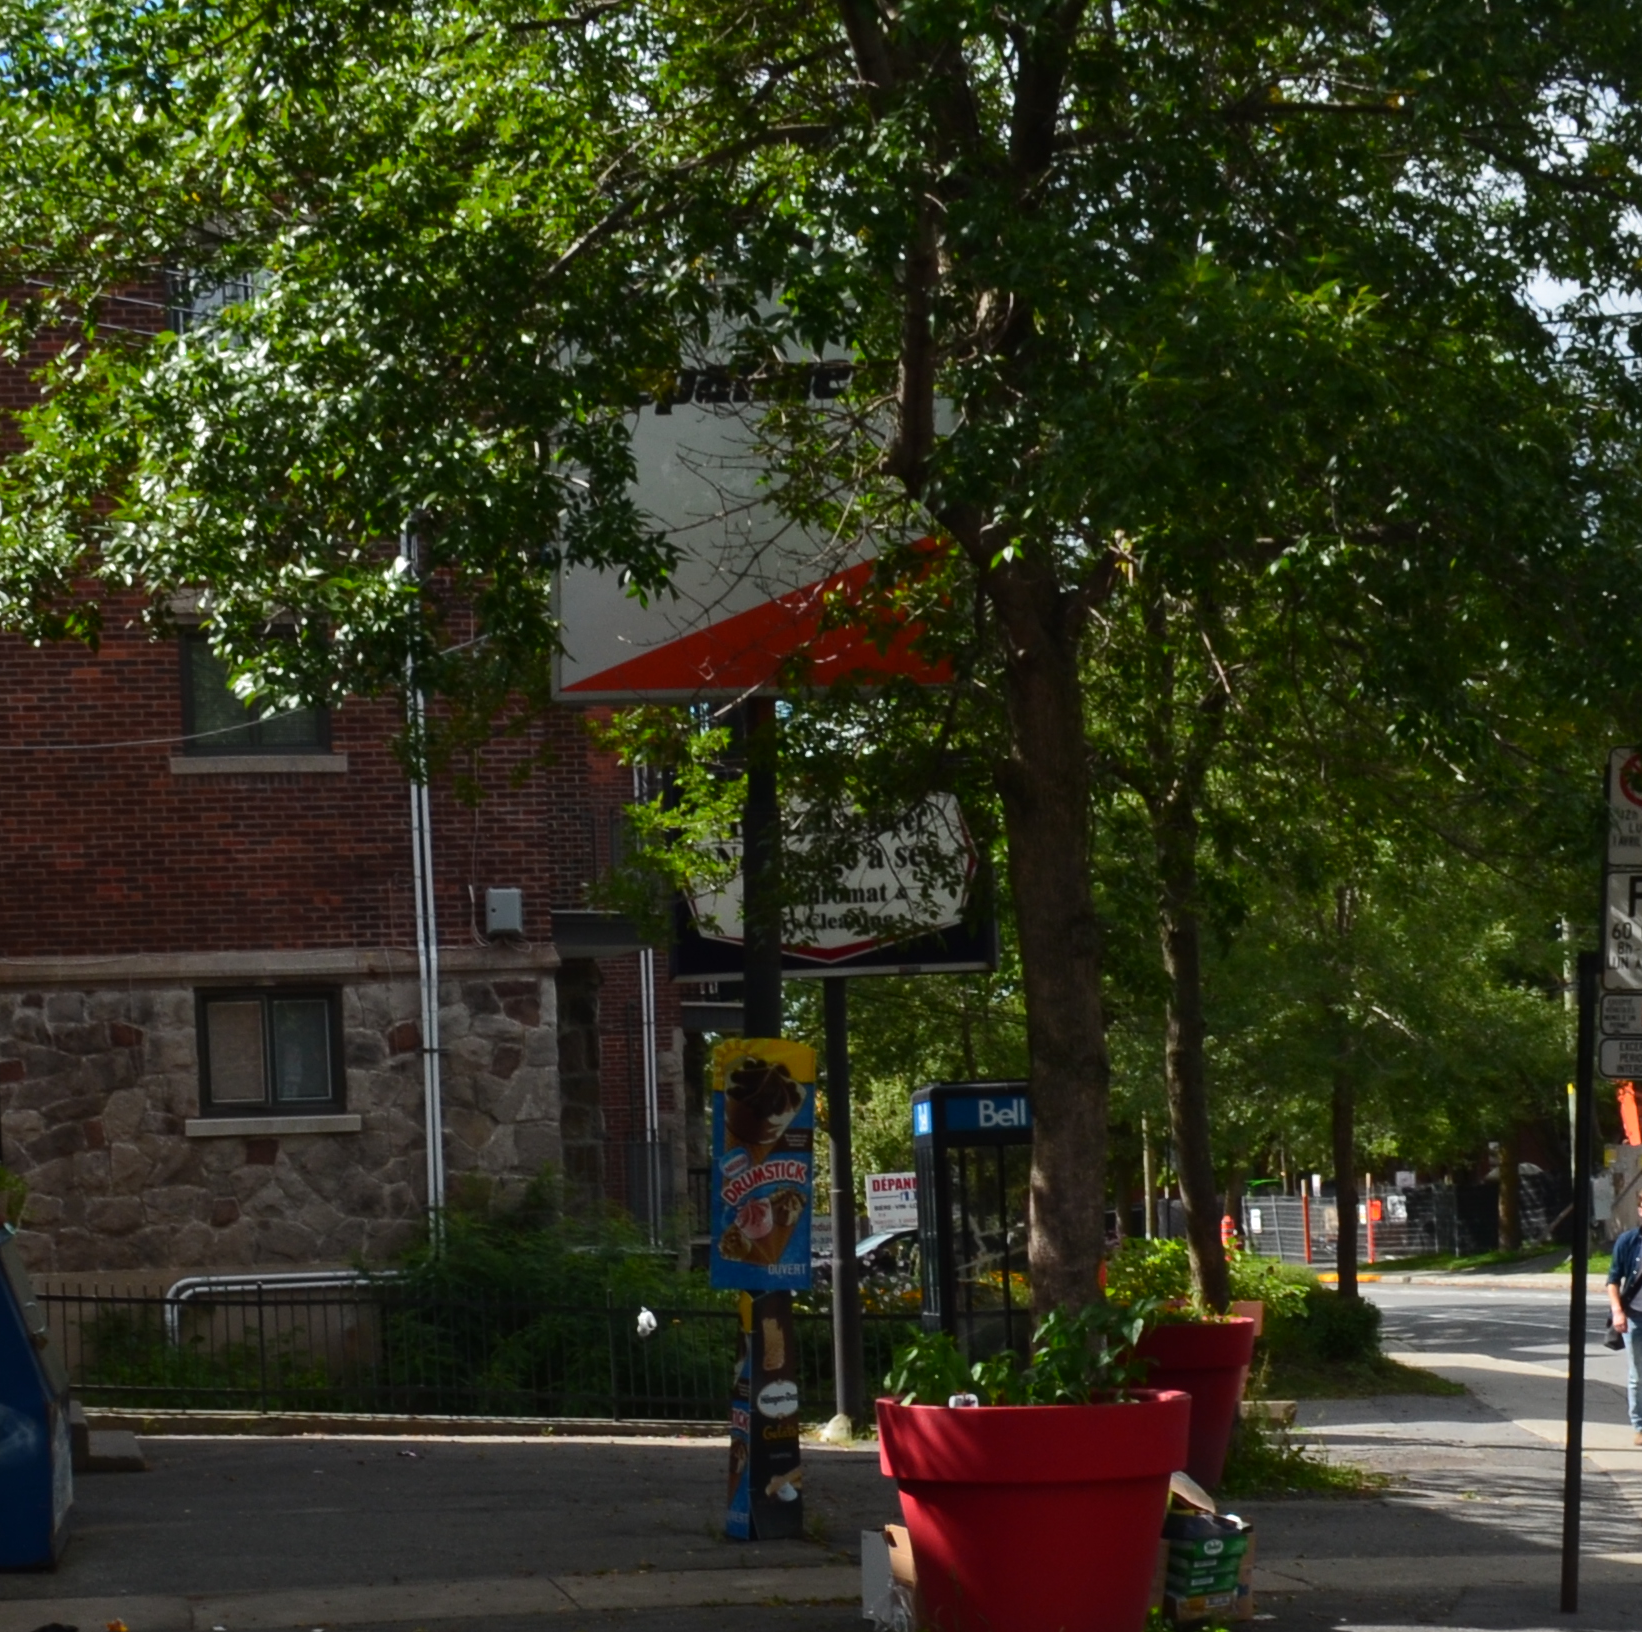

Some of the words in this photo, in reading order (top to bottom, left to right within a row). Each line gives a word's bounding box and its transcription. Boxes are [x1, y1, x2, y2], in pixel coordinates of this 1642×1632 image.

[1611, 922, 1633, 940] 60
[1606, 956, 1630, 970] LUN
[978, 1098, 1026, 1127] Bell
[721, 1160, 807, 1206] DRUMSTICK
[767, 1263, 807, 1276] OUVERT
